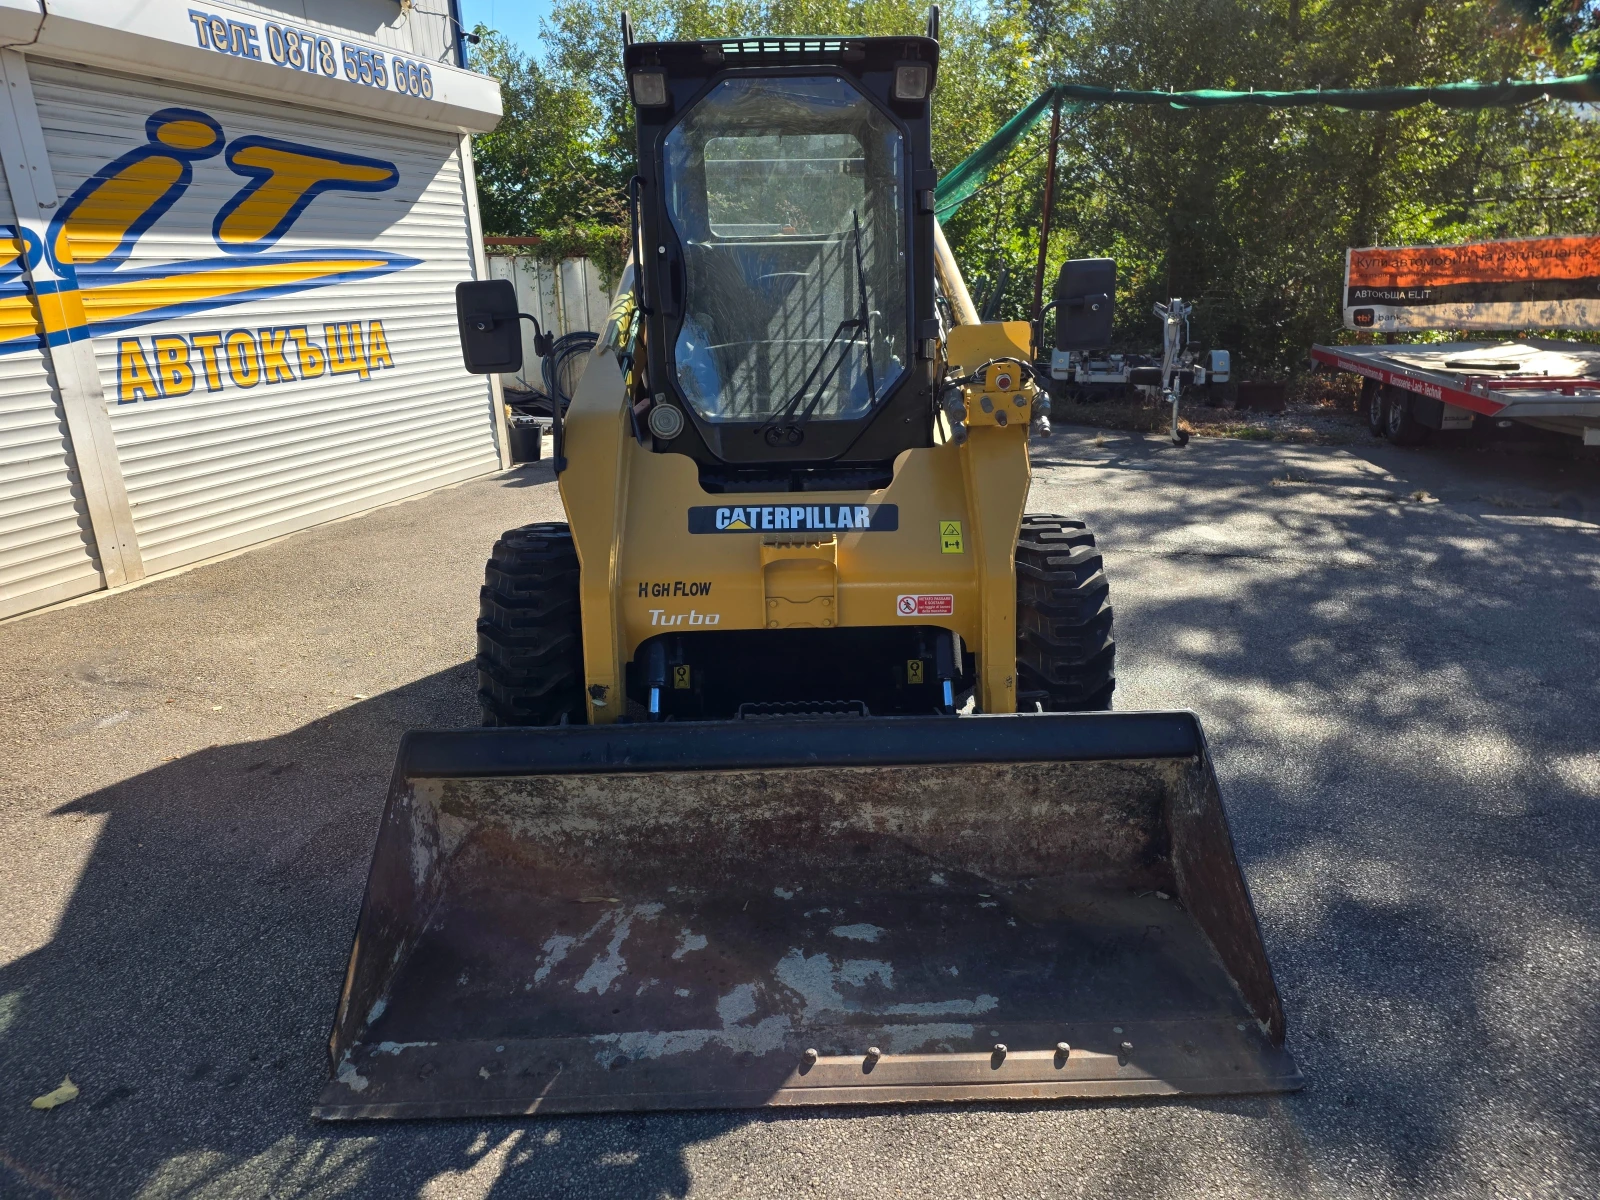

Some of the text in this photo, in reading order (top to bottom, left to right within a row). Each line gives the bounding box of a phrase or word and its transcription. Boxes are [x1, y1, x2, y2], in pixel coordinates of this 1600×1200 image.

[188, 8, 434, 100] тел: 0878 555 666
[1356, 257, 1389, 269] Купи
[1391, 252, 1471, 268] автомобил
[1475, 251, 1493, 262] на
[1354, 289, 1432, 300] АВТОКЪЩА ELIT
[1377, 313, 1402, 322] bank
[117, 319, 395, 405] АВТОКЪЩА
[715, 506, 870, 529] CATERPILLAR
[648, 609, 720, 626] Turbo
